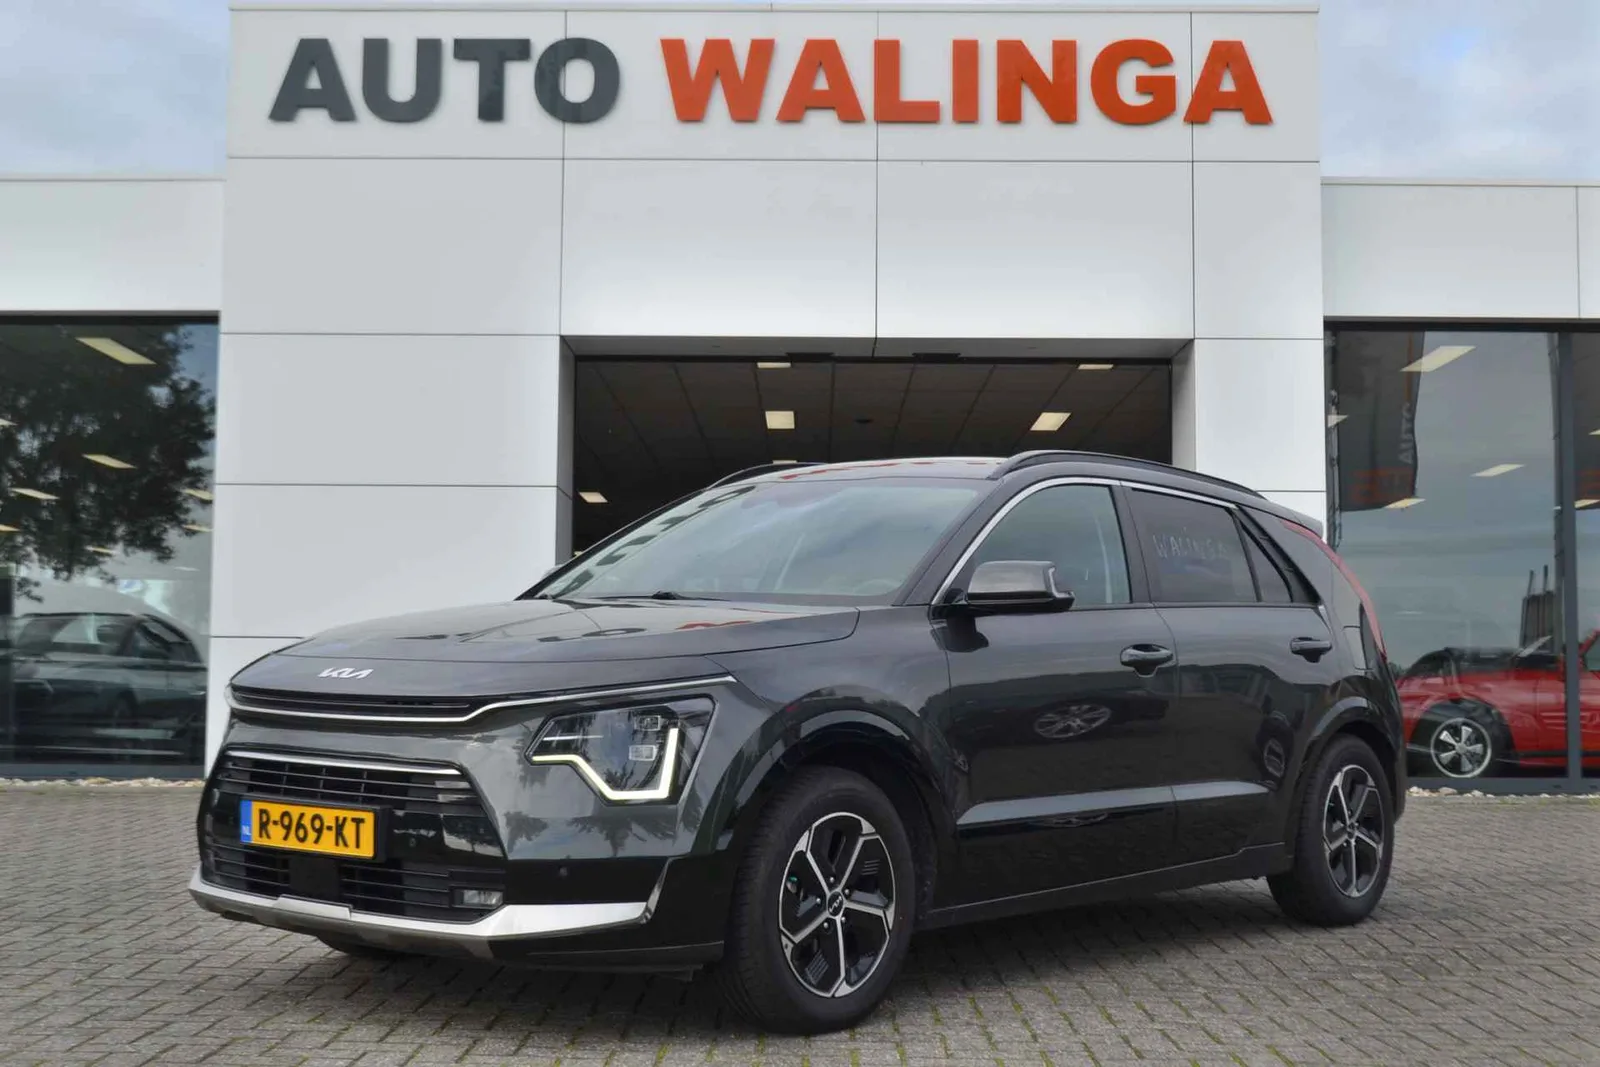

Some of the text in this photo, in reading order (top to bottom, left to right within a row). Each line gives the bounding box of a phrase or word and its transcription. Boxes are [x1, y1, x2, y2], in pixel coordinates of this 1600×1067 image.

[268, 38, 1273, 125] AUTO WALINGA
[318, 667, 374, 679] KIA
[258, 808, 366, 849] R-969-KT
